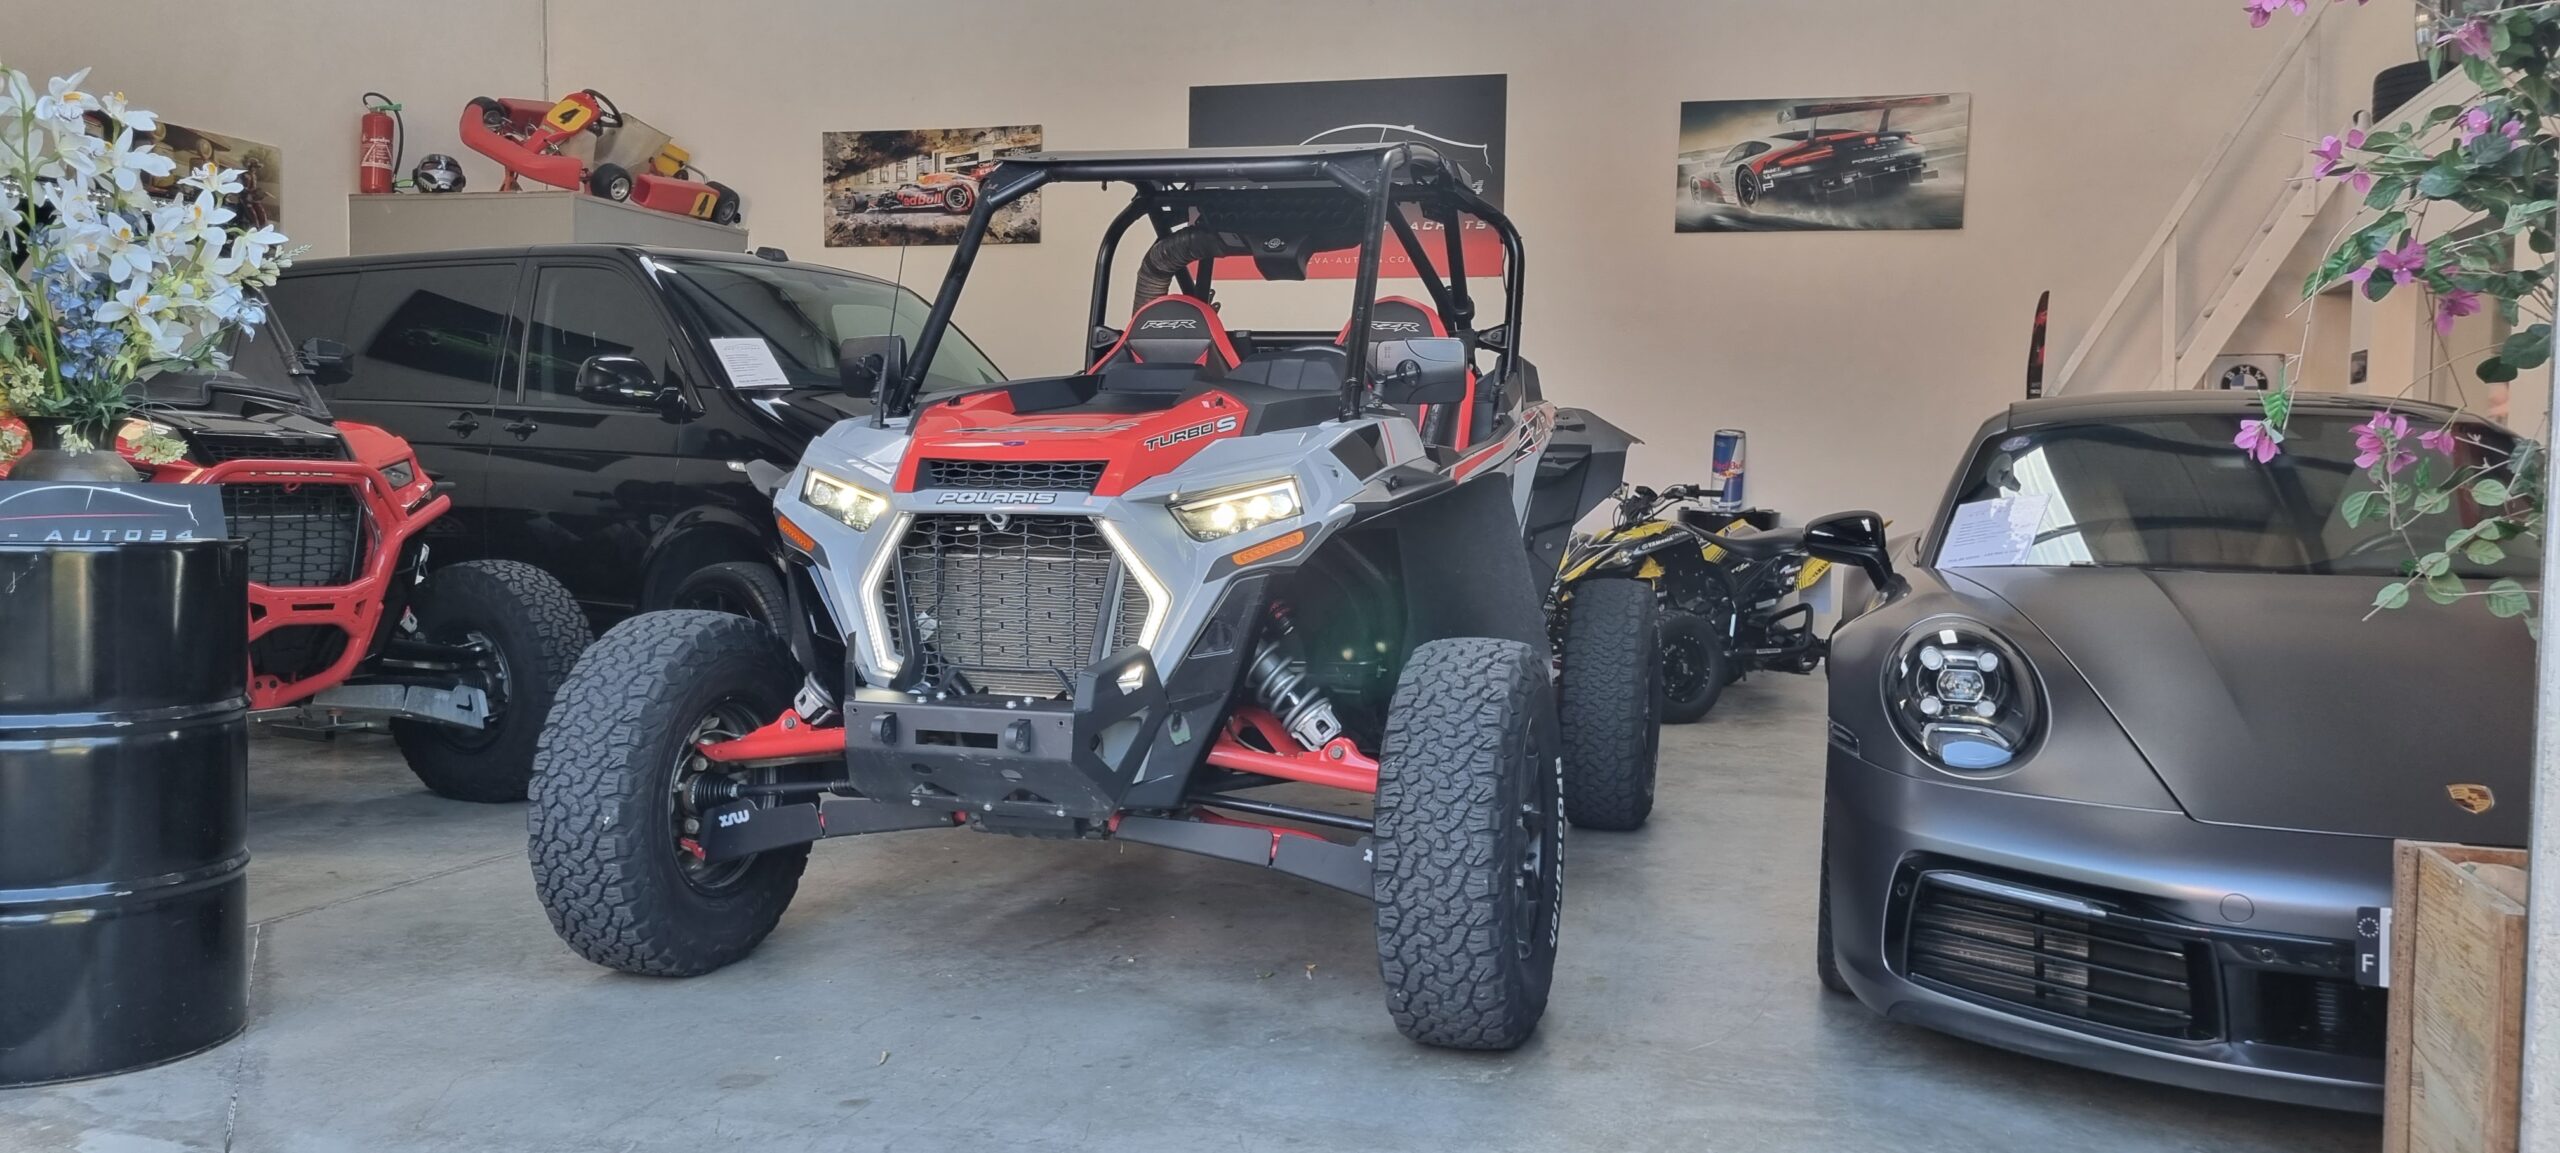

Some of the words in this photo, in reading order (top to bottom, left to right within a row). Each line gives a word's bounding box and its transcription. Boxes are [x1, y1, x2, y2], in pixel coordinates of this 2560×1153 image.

[558, 108, 581, 124] 4
[698, 195, 709, 216] 4
[1410, 220, 1487, 231] ACHTS
[1140, 319, 1197, 330] RZR
[2224, 365, 2266, 380] BMW
[1143, 422, 1214, 451] TURBO
[1215, 416, 1237, 432] S
[936, 492, 1057, 505] POLARIS
[44, 529, 193, 542] AUTO34
[2361, 953, 2375, 973] F
